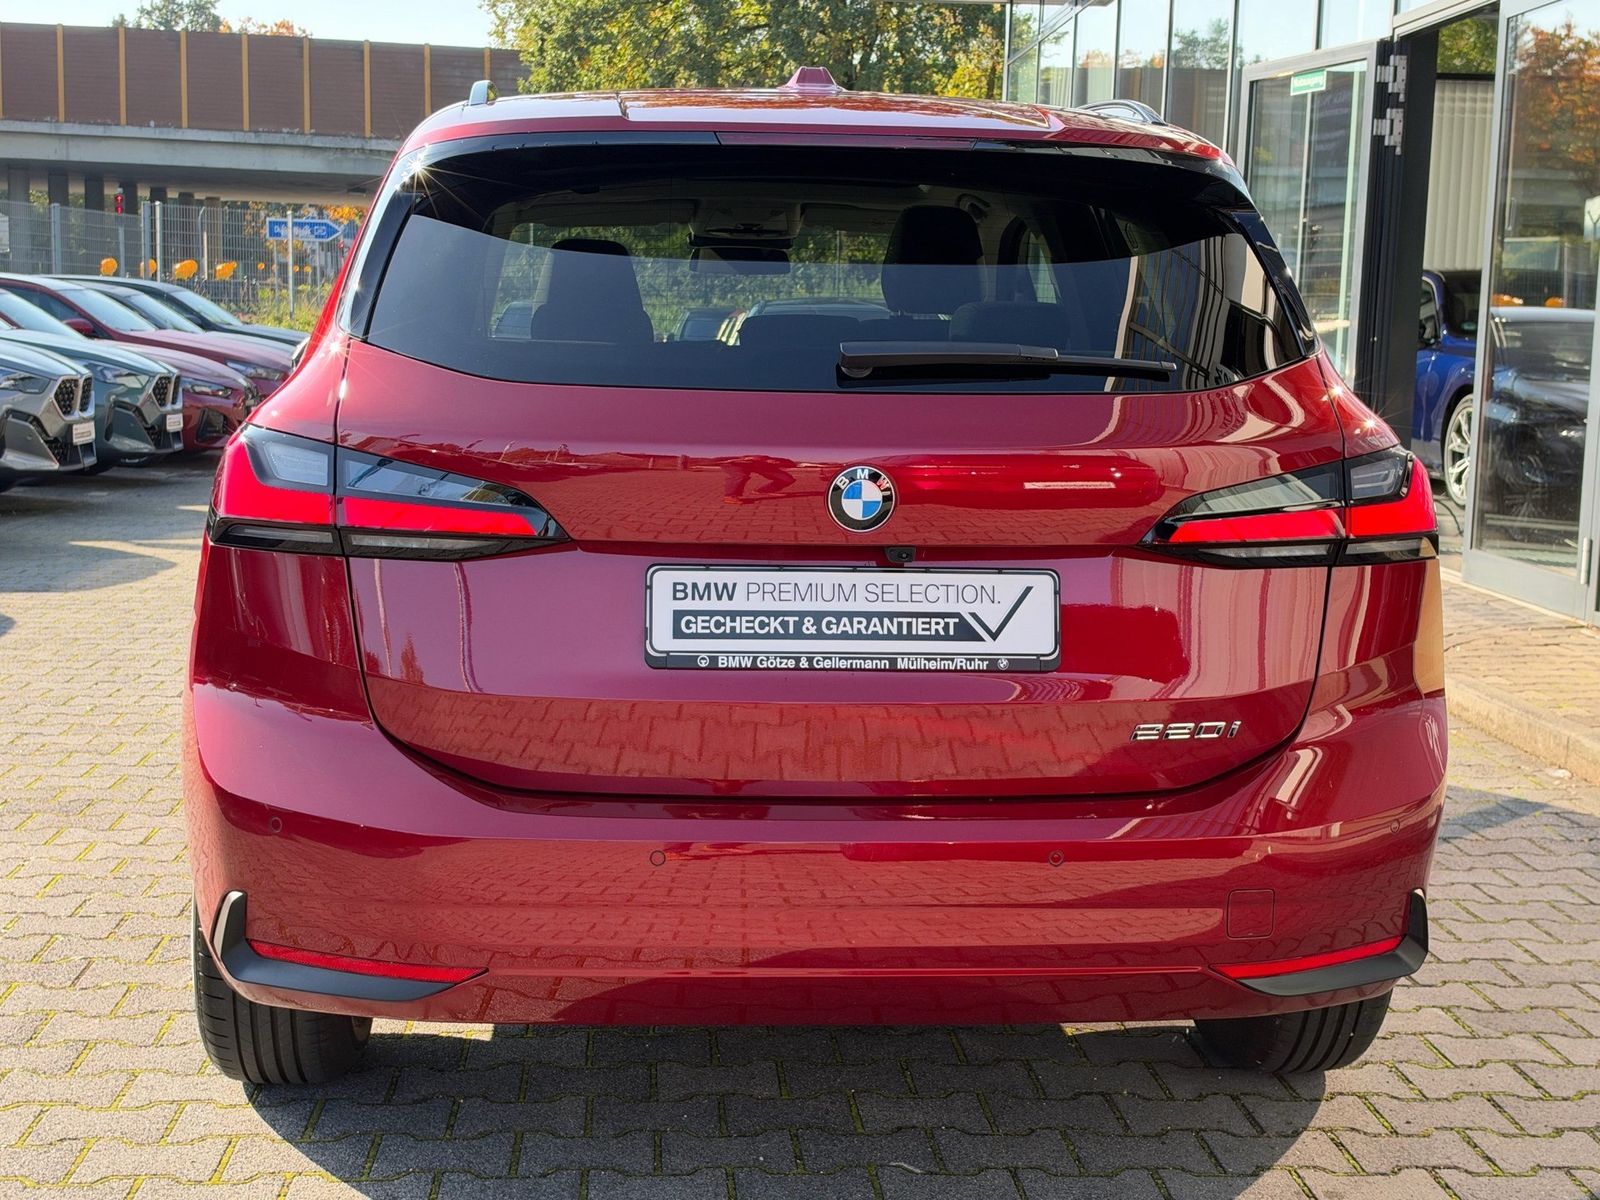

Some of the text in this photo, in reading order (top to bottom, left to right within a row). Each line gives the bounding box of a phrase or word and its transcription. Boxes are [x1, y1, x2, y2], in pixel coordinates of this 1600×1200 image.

[836, 468, 891, 496] BMW
[672, 581, 1001, 604] BMW PREMIUM SELECTION.
[680, 615, 960, 636] GECHECKT & GARANTIERT
[717, 655, 989, 671] BMW Götze & Gellermann Mülheim/Ruhr
[1130, 720, 1242, 742] 220i
